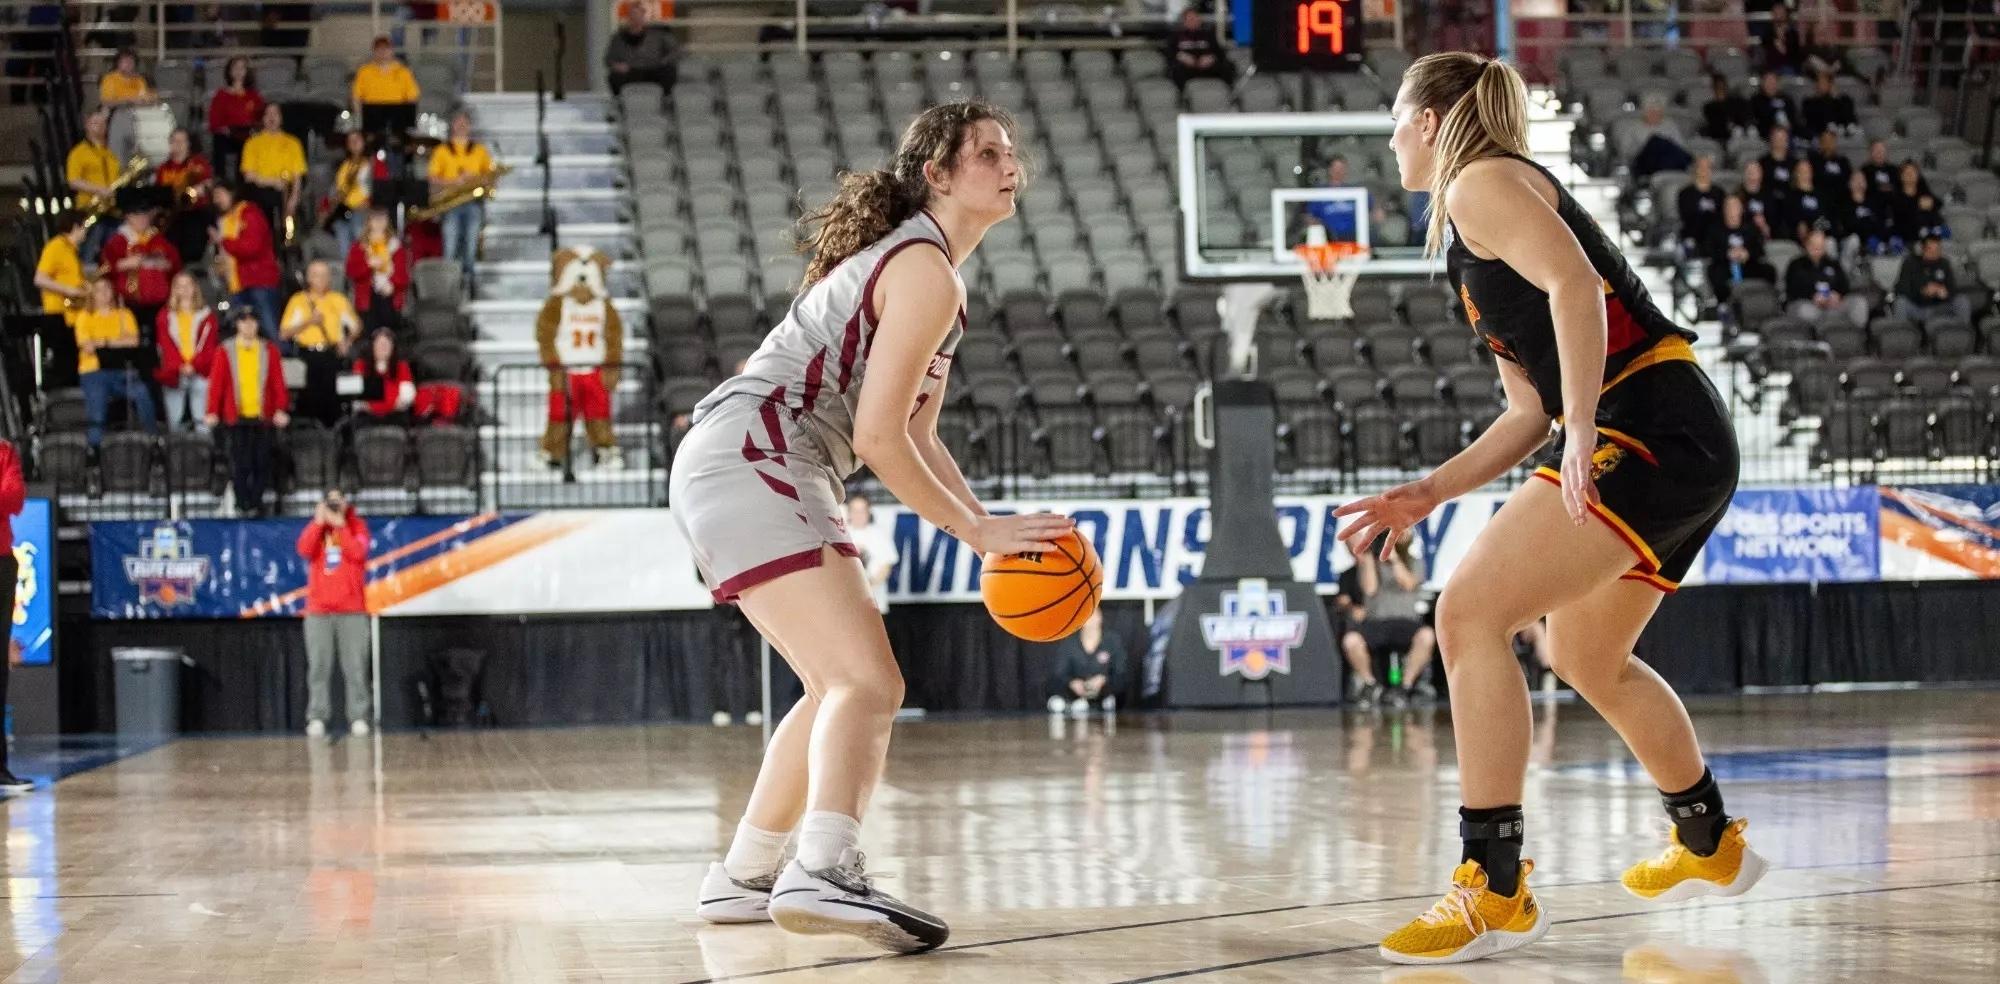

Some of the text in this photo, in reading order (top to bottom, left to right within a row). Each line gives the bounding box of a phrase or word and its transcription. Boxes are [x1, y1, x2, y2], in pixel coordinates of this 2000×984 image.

[1298, 1, 1343, 54] 19
[1780, 511, 1868, 535] SPORTS
[1734, 535, 1849, 559] NETWORK
